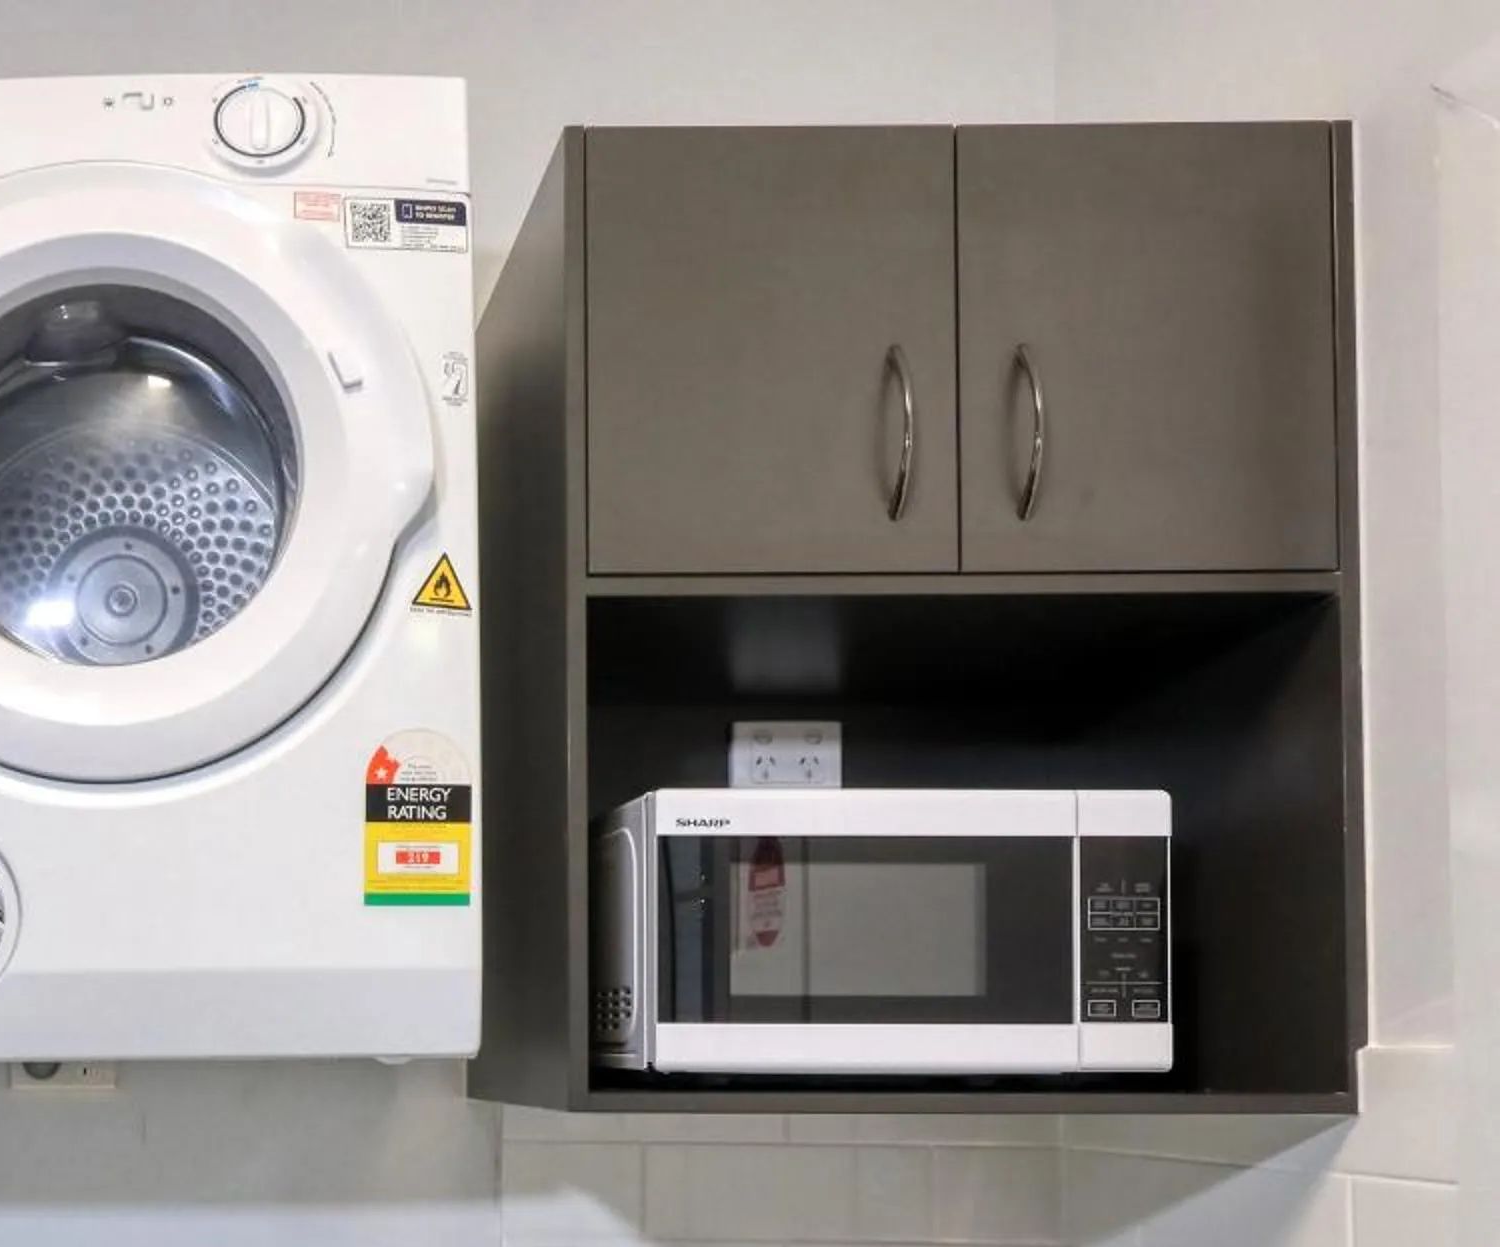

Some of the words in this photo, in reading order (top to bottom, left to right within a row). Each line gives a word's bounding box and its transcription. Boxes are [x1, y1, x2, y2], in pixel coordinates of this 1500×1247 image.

[387, 787, 452, 803] ENERGY
[387, 805, 447, 820] RATING
[675, 817, 731, 828] SHARP
